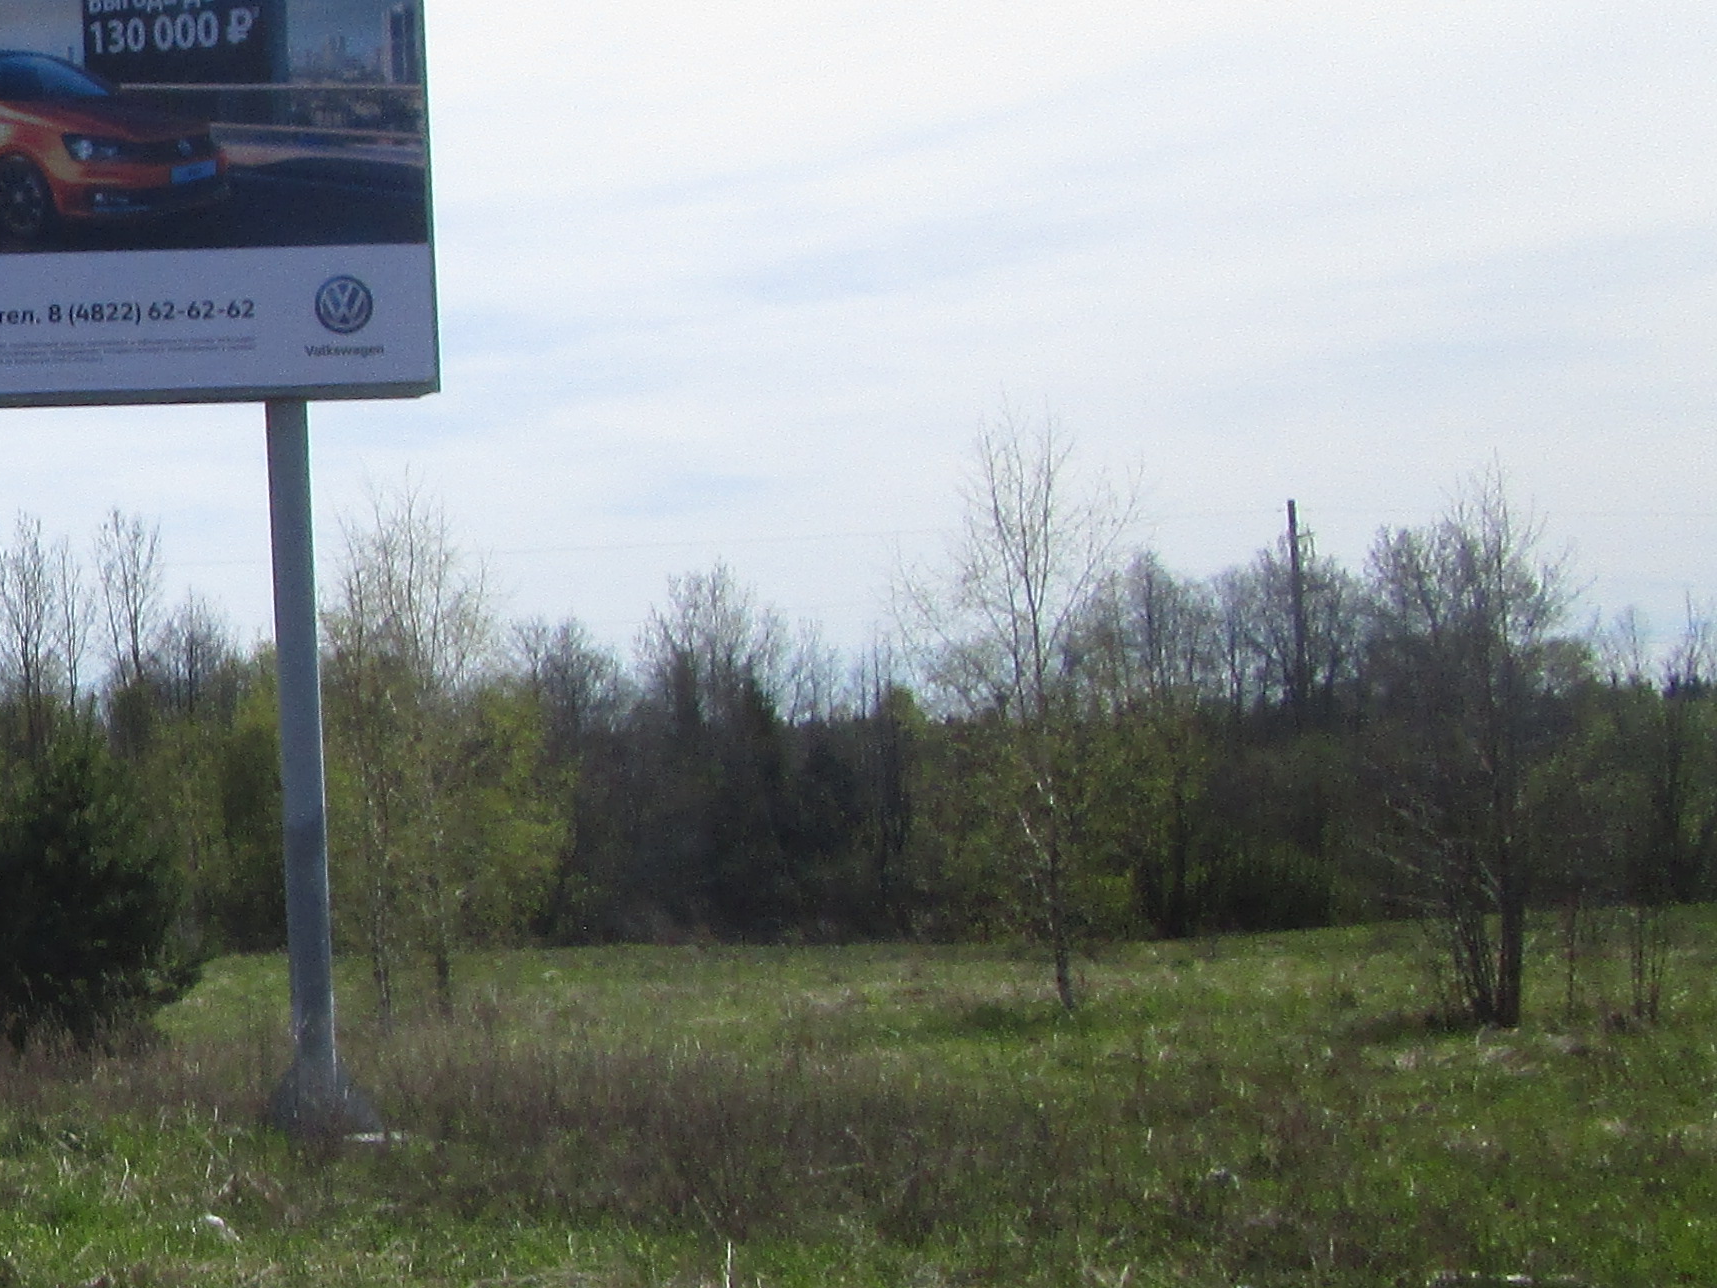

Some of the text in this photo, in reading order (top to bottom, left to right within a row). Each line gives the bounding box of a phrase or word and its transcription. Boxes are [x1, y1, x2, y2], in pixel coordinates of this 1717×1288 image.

[89, 16, 146, 54] 130
[154, 11, 220, 51] 000
[47, 303, 63, 323] 8
[68, 301, 142, 326] (4822)
[147, 298, 256, 322] 62-62-62
